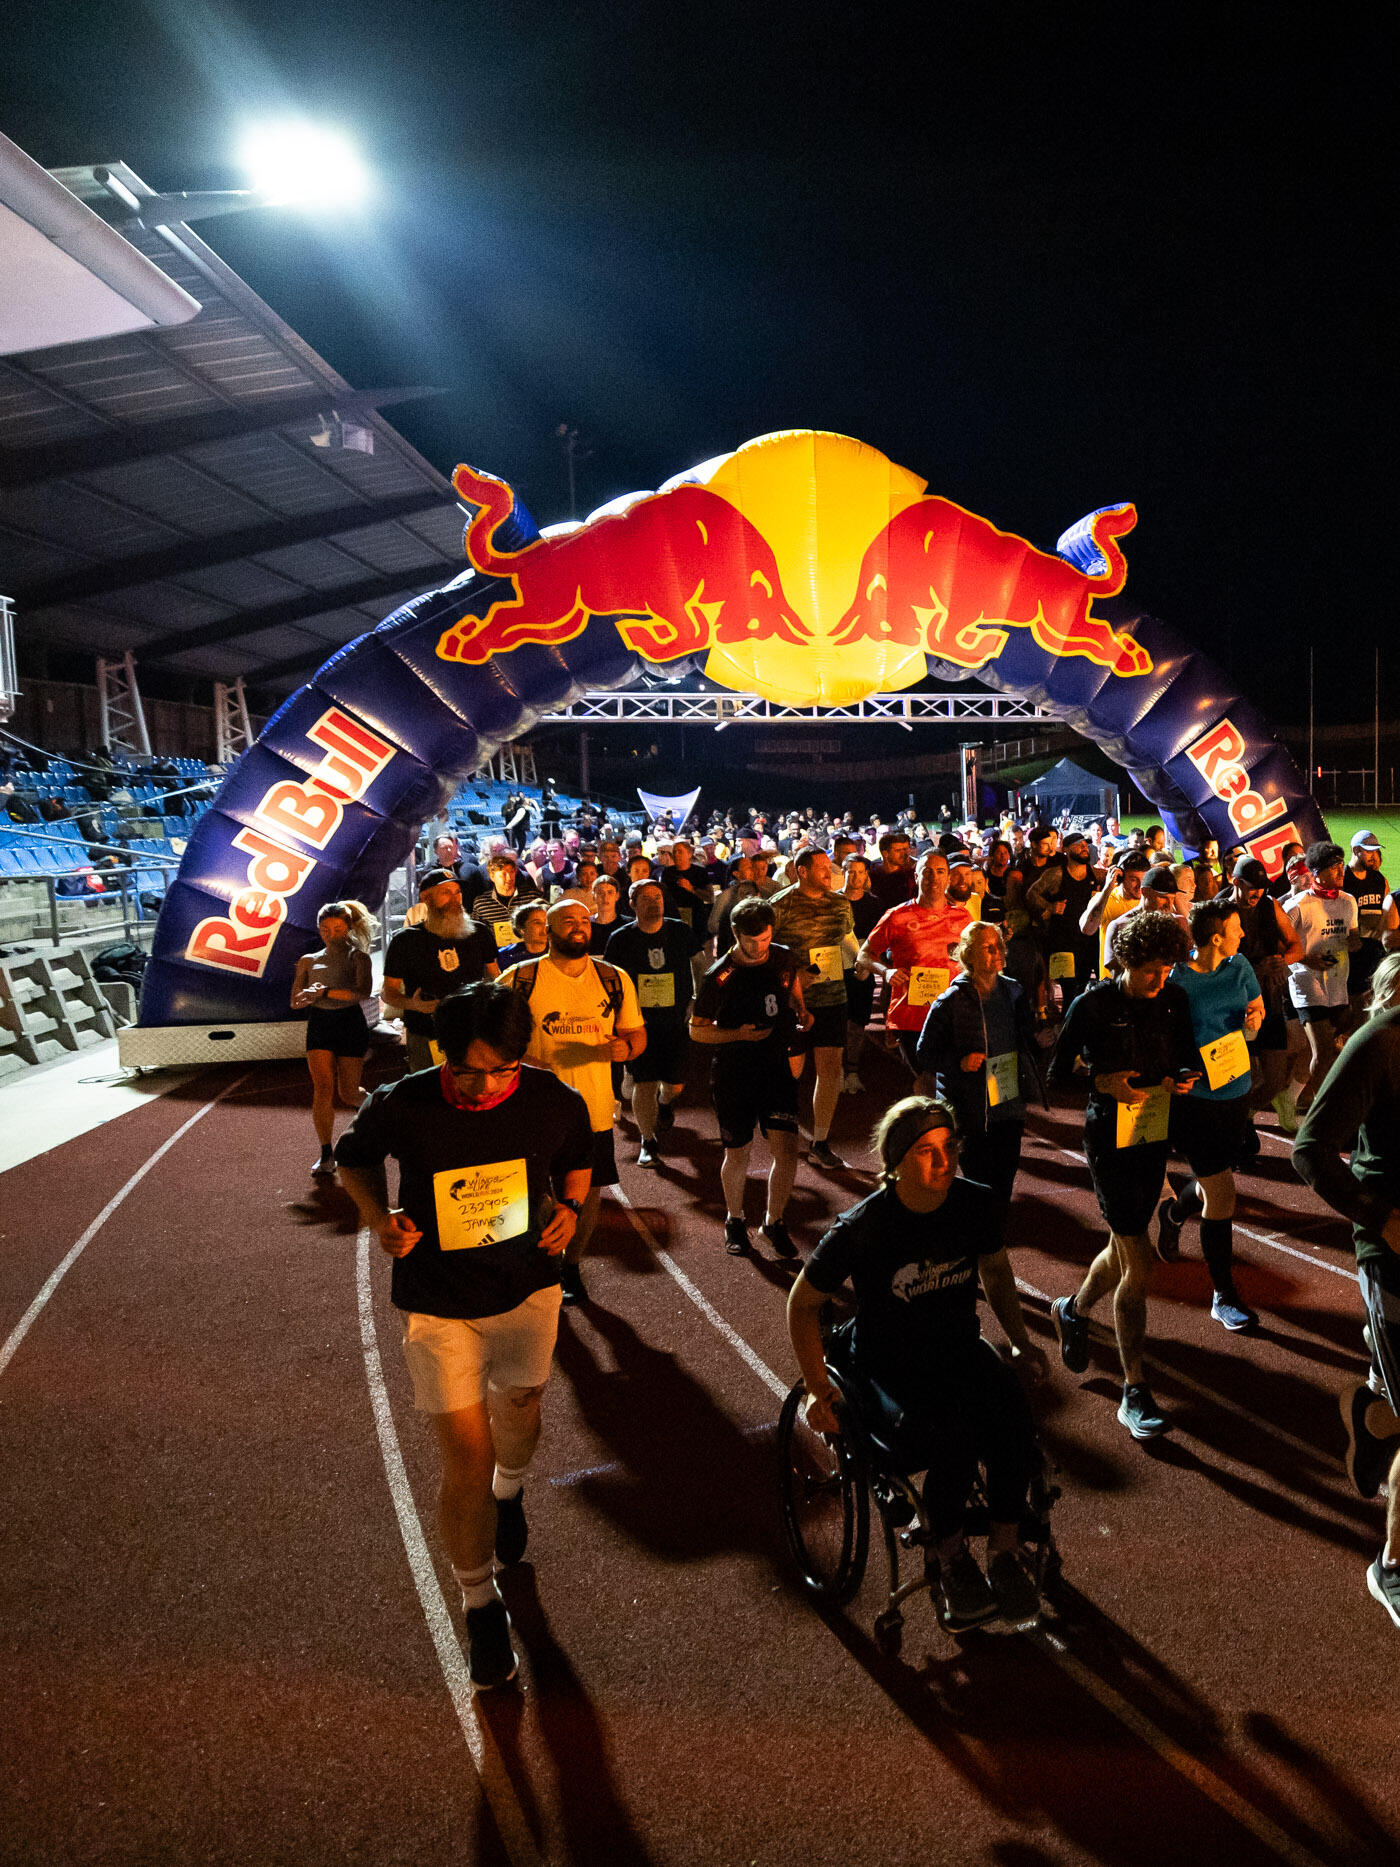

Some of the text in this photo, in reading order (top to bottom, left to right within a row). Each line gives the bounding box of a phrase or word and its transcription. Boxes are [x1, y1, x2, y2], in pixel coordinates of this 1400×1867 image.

[1185, 718, 1288, 839] Red
[185, 706, 398, 978] Red Bull
[765, 994, 778, 1016] 8
[462, 1214, 505, 1231] JAMES
